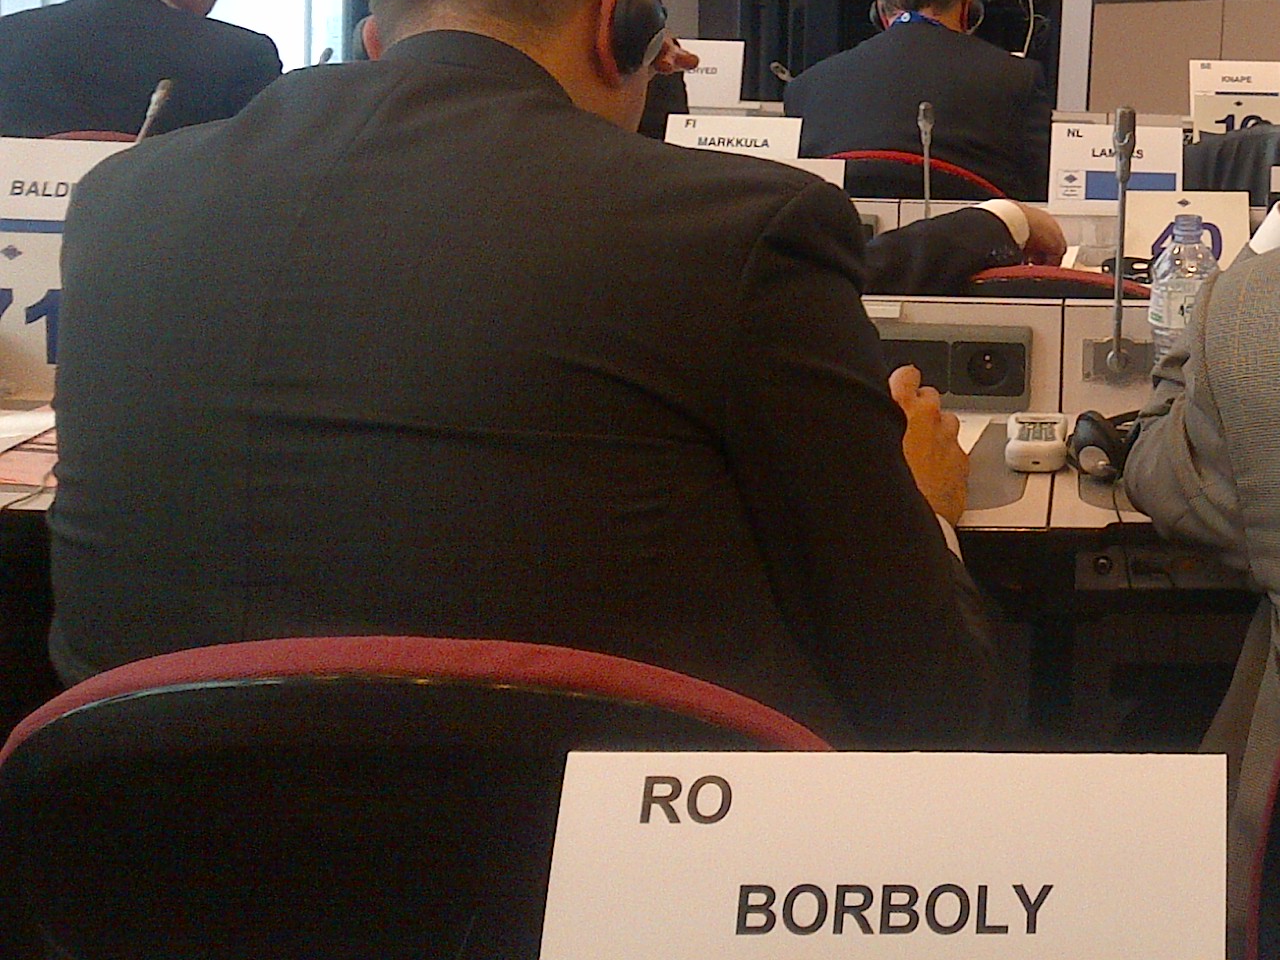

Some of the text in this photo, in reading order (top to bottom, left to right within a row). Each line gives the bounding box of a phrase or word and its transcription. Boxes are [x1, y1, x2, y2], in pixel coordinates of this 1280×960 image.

[684, 118, 697, 128] FI
[1067, 127, 1083, 138] NL
[698, 136, 770, 148] MARKKULA
[638, 774, 733, 825] RO
[734, 883, 1055, 937] BORBOLY
